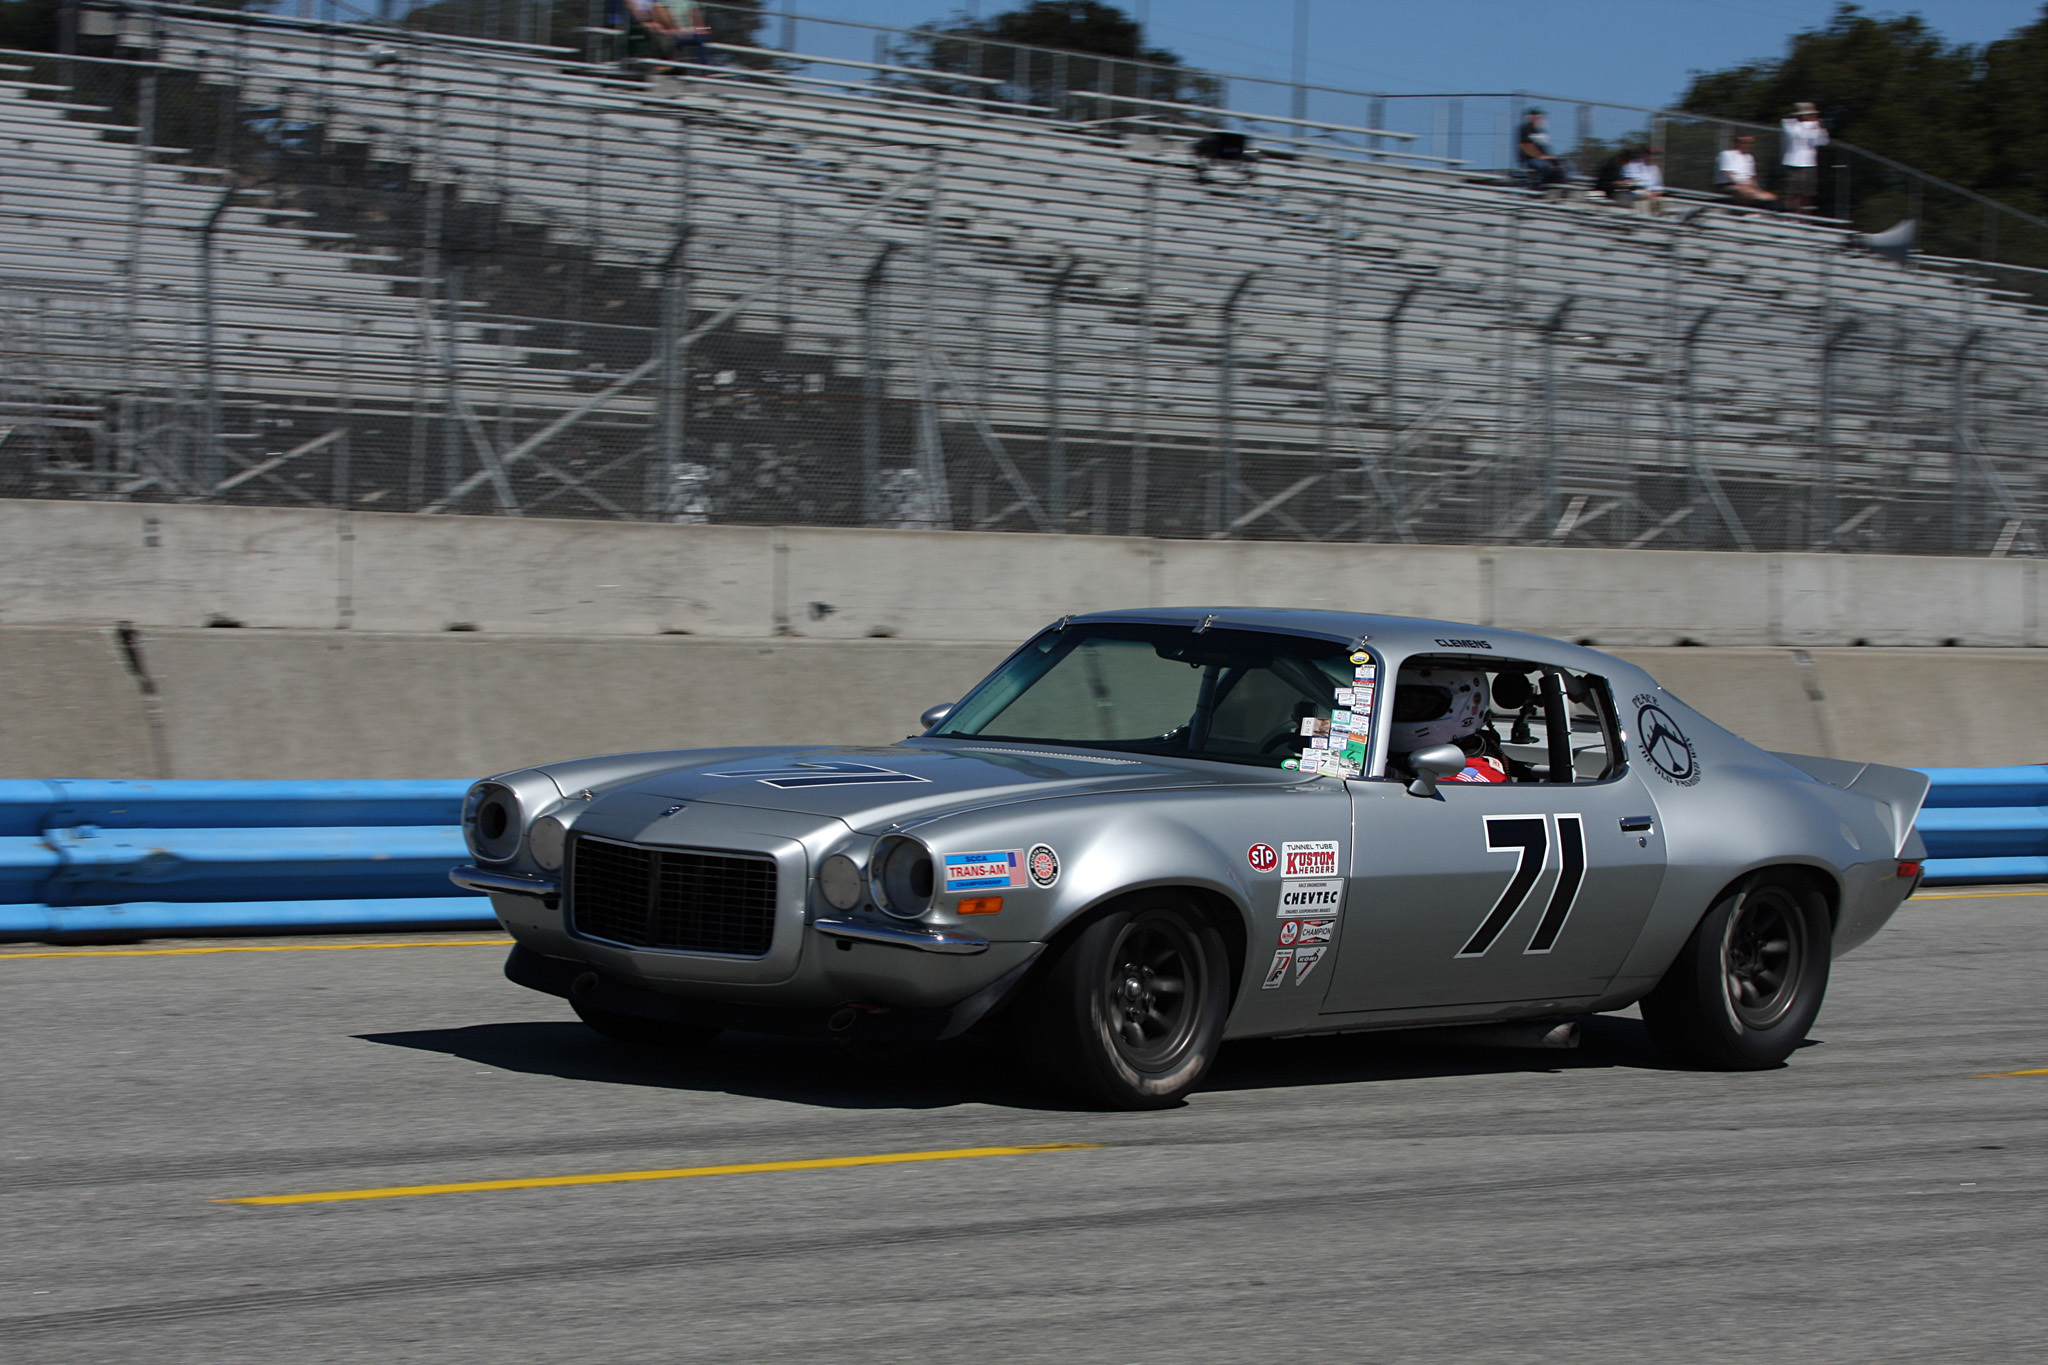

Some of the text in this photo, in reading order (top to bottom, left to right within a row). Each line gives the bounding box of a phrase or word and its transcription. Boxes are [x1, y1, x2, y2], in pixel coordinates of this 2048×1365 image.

[1434, 638, 1493, 650] CLEMENS
[1654, 766, 1673, 784] OLD
[1251, 845, 1274, 868] STP
[1286, 851, 1335, 875] KUSTOM
[949, 864, 1007, 878] TRANS-AM
[1299, 865, 1335, 875] HEADERS
[1453, 812, 1588, 959] 71
[1284, 890, 1338, 905] CHEVTEC
[1302, 927, 1331, 936] CHAMPION
